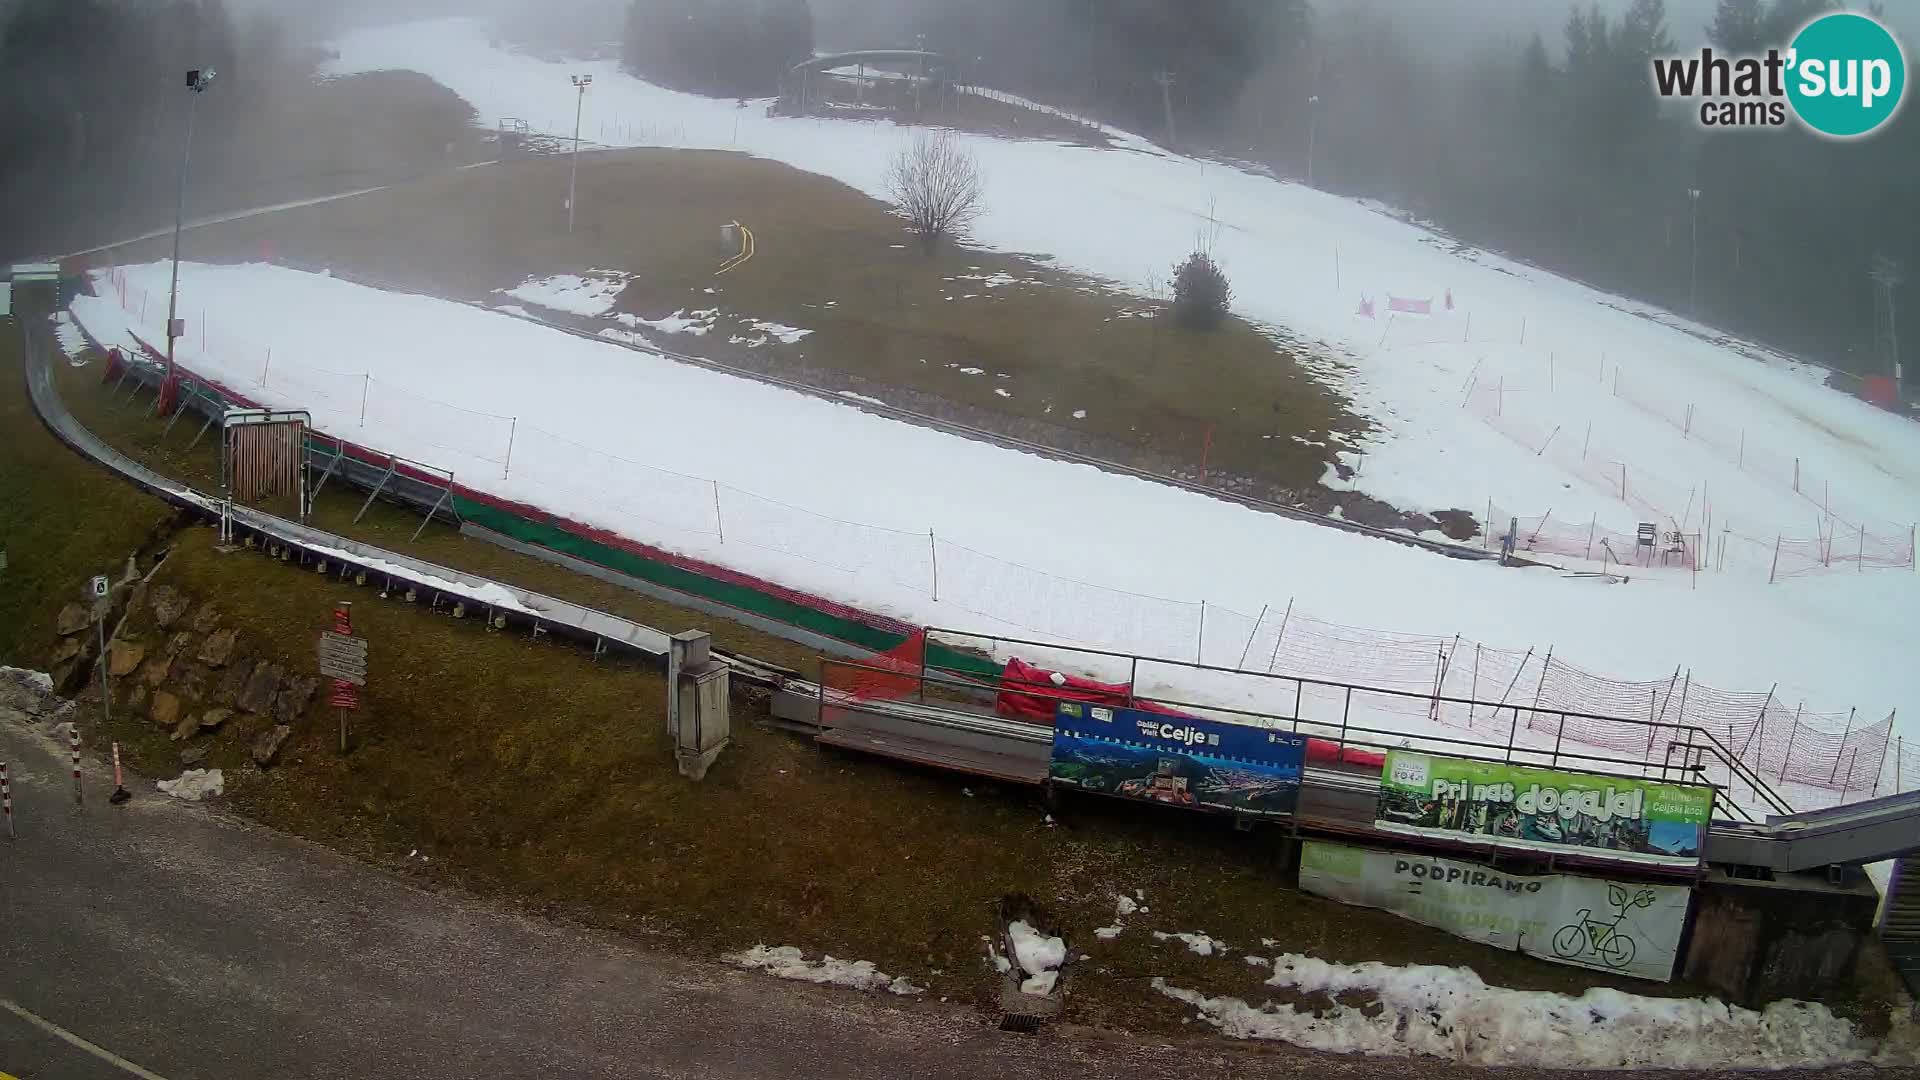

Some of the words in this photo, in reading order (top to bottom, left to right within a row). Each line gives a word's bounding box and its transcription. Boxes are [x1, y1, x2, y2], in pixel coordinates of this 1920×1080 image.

[1141, 727, 1159, 737] Visit
[1159, 723, 1206, 746] Celje
[1431, 778, 1468, 801] Pri
[1472, 782, 1514, 803] nas
[1516, 783, 1644, 822] dogaja!
[1394, 859, 1543, 894] PODPIRAMO
